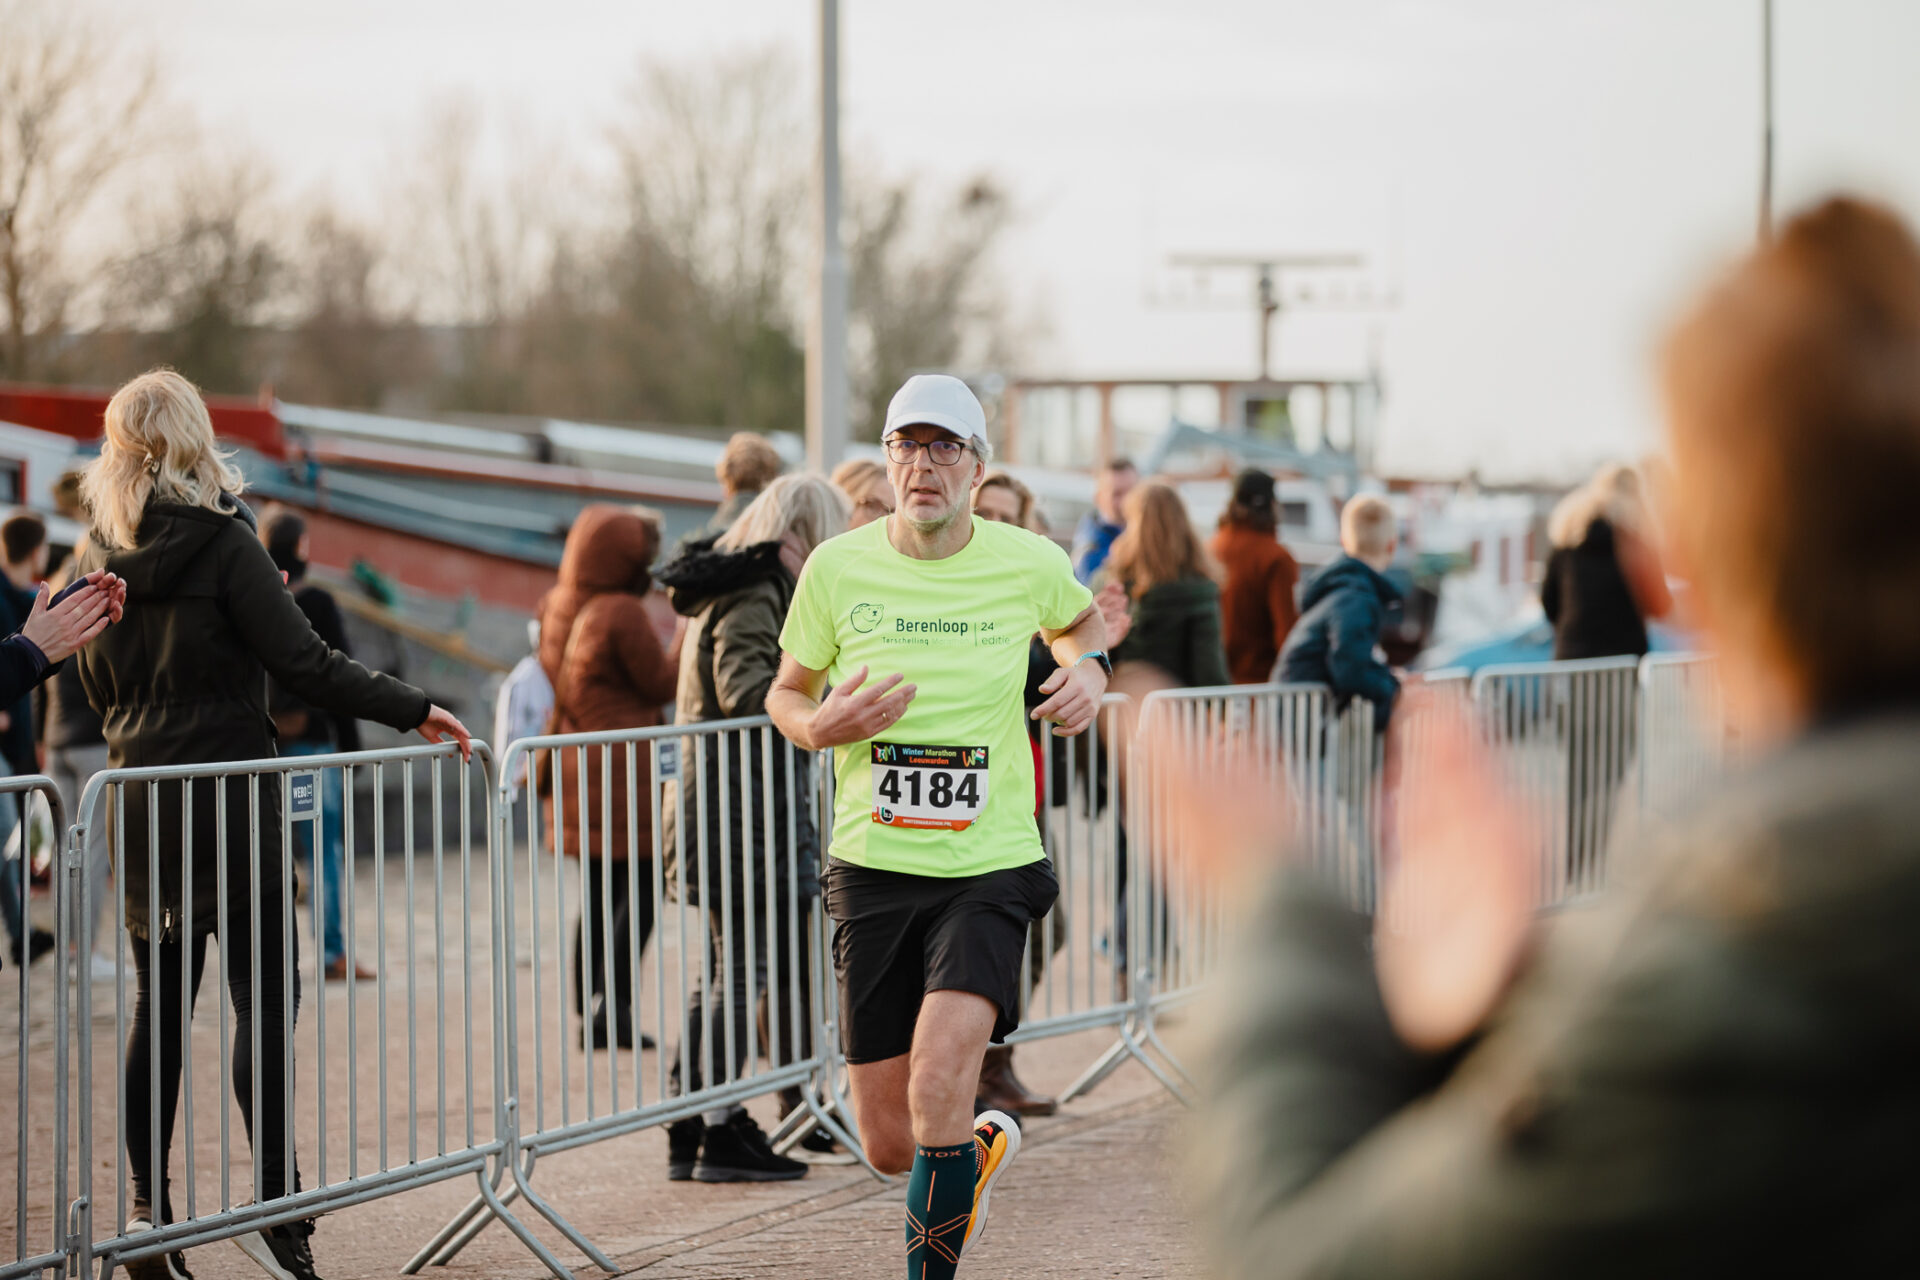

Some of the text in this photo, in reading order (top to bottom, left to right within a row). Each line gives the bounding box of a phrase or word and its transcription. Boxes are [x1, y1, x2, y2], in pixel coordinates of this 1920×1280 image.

[896, 618, 994, 636] Berenloop 24
[882, 636, 929, 646] Terschelling
[981, 635, 1010, 646] editie
[902, 747, 957, 758] Winter Marathon
[293, 786, 307, 799] WEBO
[879, 769, 980, 808] 4184
